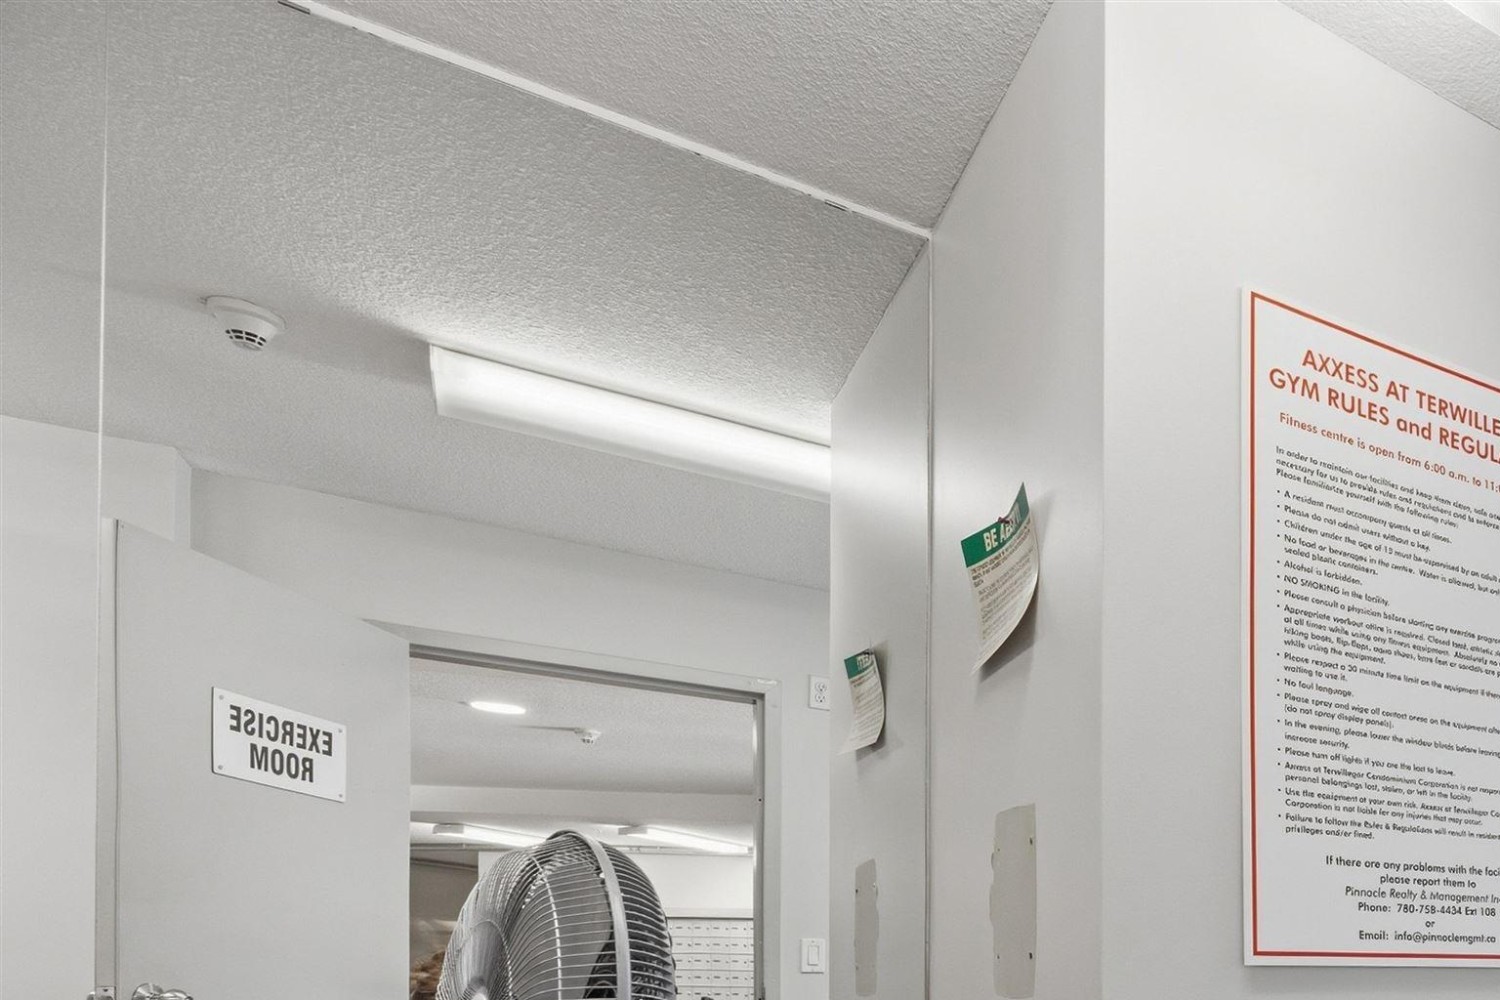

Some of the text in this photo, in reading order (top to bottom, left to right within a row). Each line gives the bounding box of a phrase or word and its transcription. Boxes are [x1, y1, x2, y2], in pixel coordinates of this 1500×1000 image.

[1302, 349, 1378, 394] AXXESS
[1385, 379, 1409, 405] AT
[1269, 368, 1320, 403] GYM
[1328, 388, 1389, 426] RULES
[1396, 417, 1432, 441] and
[1279, 413, 1317, 435] Fitness
[1320, 429, 1354, 446] centre
[1357, 438, 1366, 450] is
[1368, 444, 1394, 459] open
[1397, 450, 1421, 468] from
[1423, 459, 1446, 476] 6:00
[1448, 470, 1470, 483] a.m.
[1472, 475, 1481, 487] to
[1325, 856, 1333, 866] If
[1336, 857, 1362, 868] there
[1383, 863, 1401, 873] any
[1403, 863, 1446, 873] problems
[1448, 866, 1467, 875] with
[1469, 866, 1483, 876] the
[1380, 874, 1476, 888] please report them to
[1345, 888, 1387, 899] Pinnacle
[1389, 890, 1417, 903] Realty
[1420, 892, 1426, 901] &
[1429, 892, 1489, 905] Management
[1358, 902, 1496, 916] Phone: 780-758-4434 Ext 108
[1359, 931, 1496, 945] Email: info@pinnaclemgmt.ca
